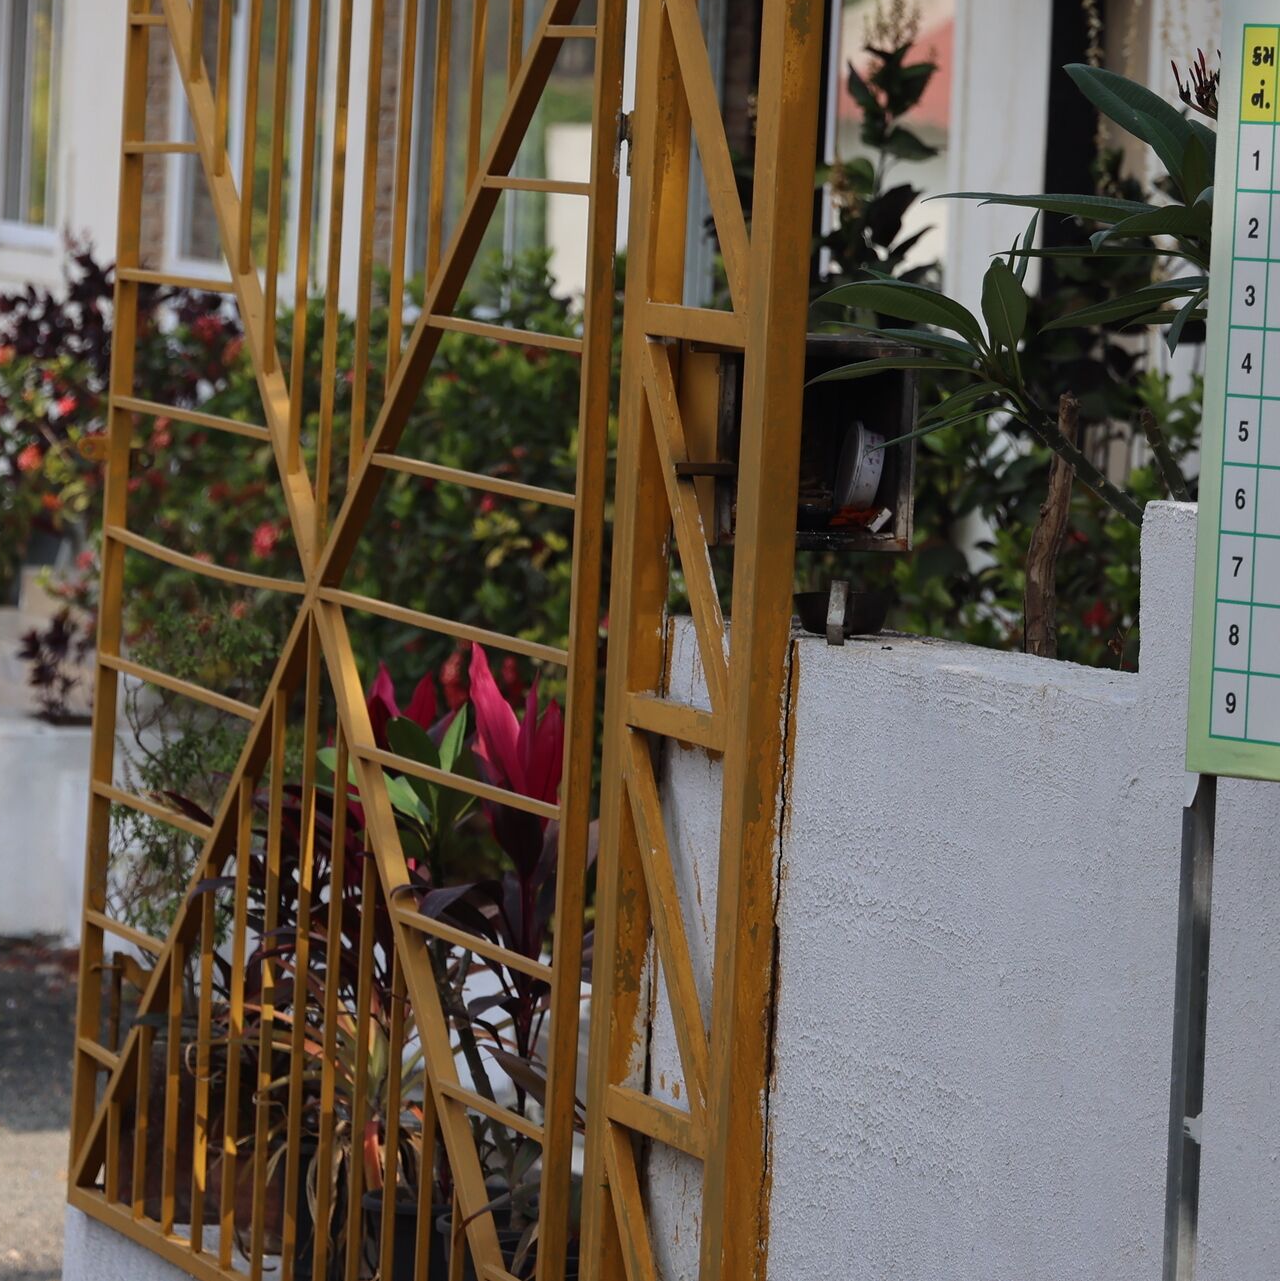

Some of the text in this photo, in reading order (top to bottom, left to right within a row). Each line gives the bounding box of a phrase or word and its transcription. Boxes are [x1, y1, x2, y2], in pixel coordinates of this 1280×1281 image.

[1251, 45, 1275, 67] ક્રમ
[1250, 79, 1271, 110] નં.
[1252, 150, 1260, 171] 1
[1247, 217, 1259, 239] 2
[1244, 284, 1256, 307] 3
[1241, 352, 1253, 374] 4
[1238, 420, 1249, 442] 5
[1235, 488, 1246, 510] 6
[1232, 556, 1244, 578] 7
[1228, 623, 1240, 646] 8
[1225, 692, 1237, 714] 9
